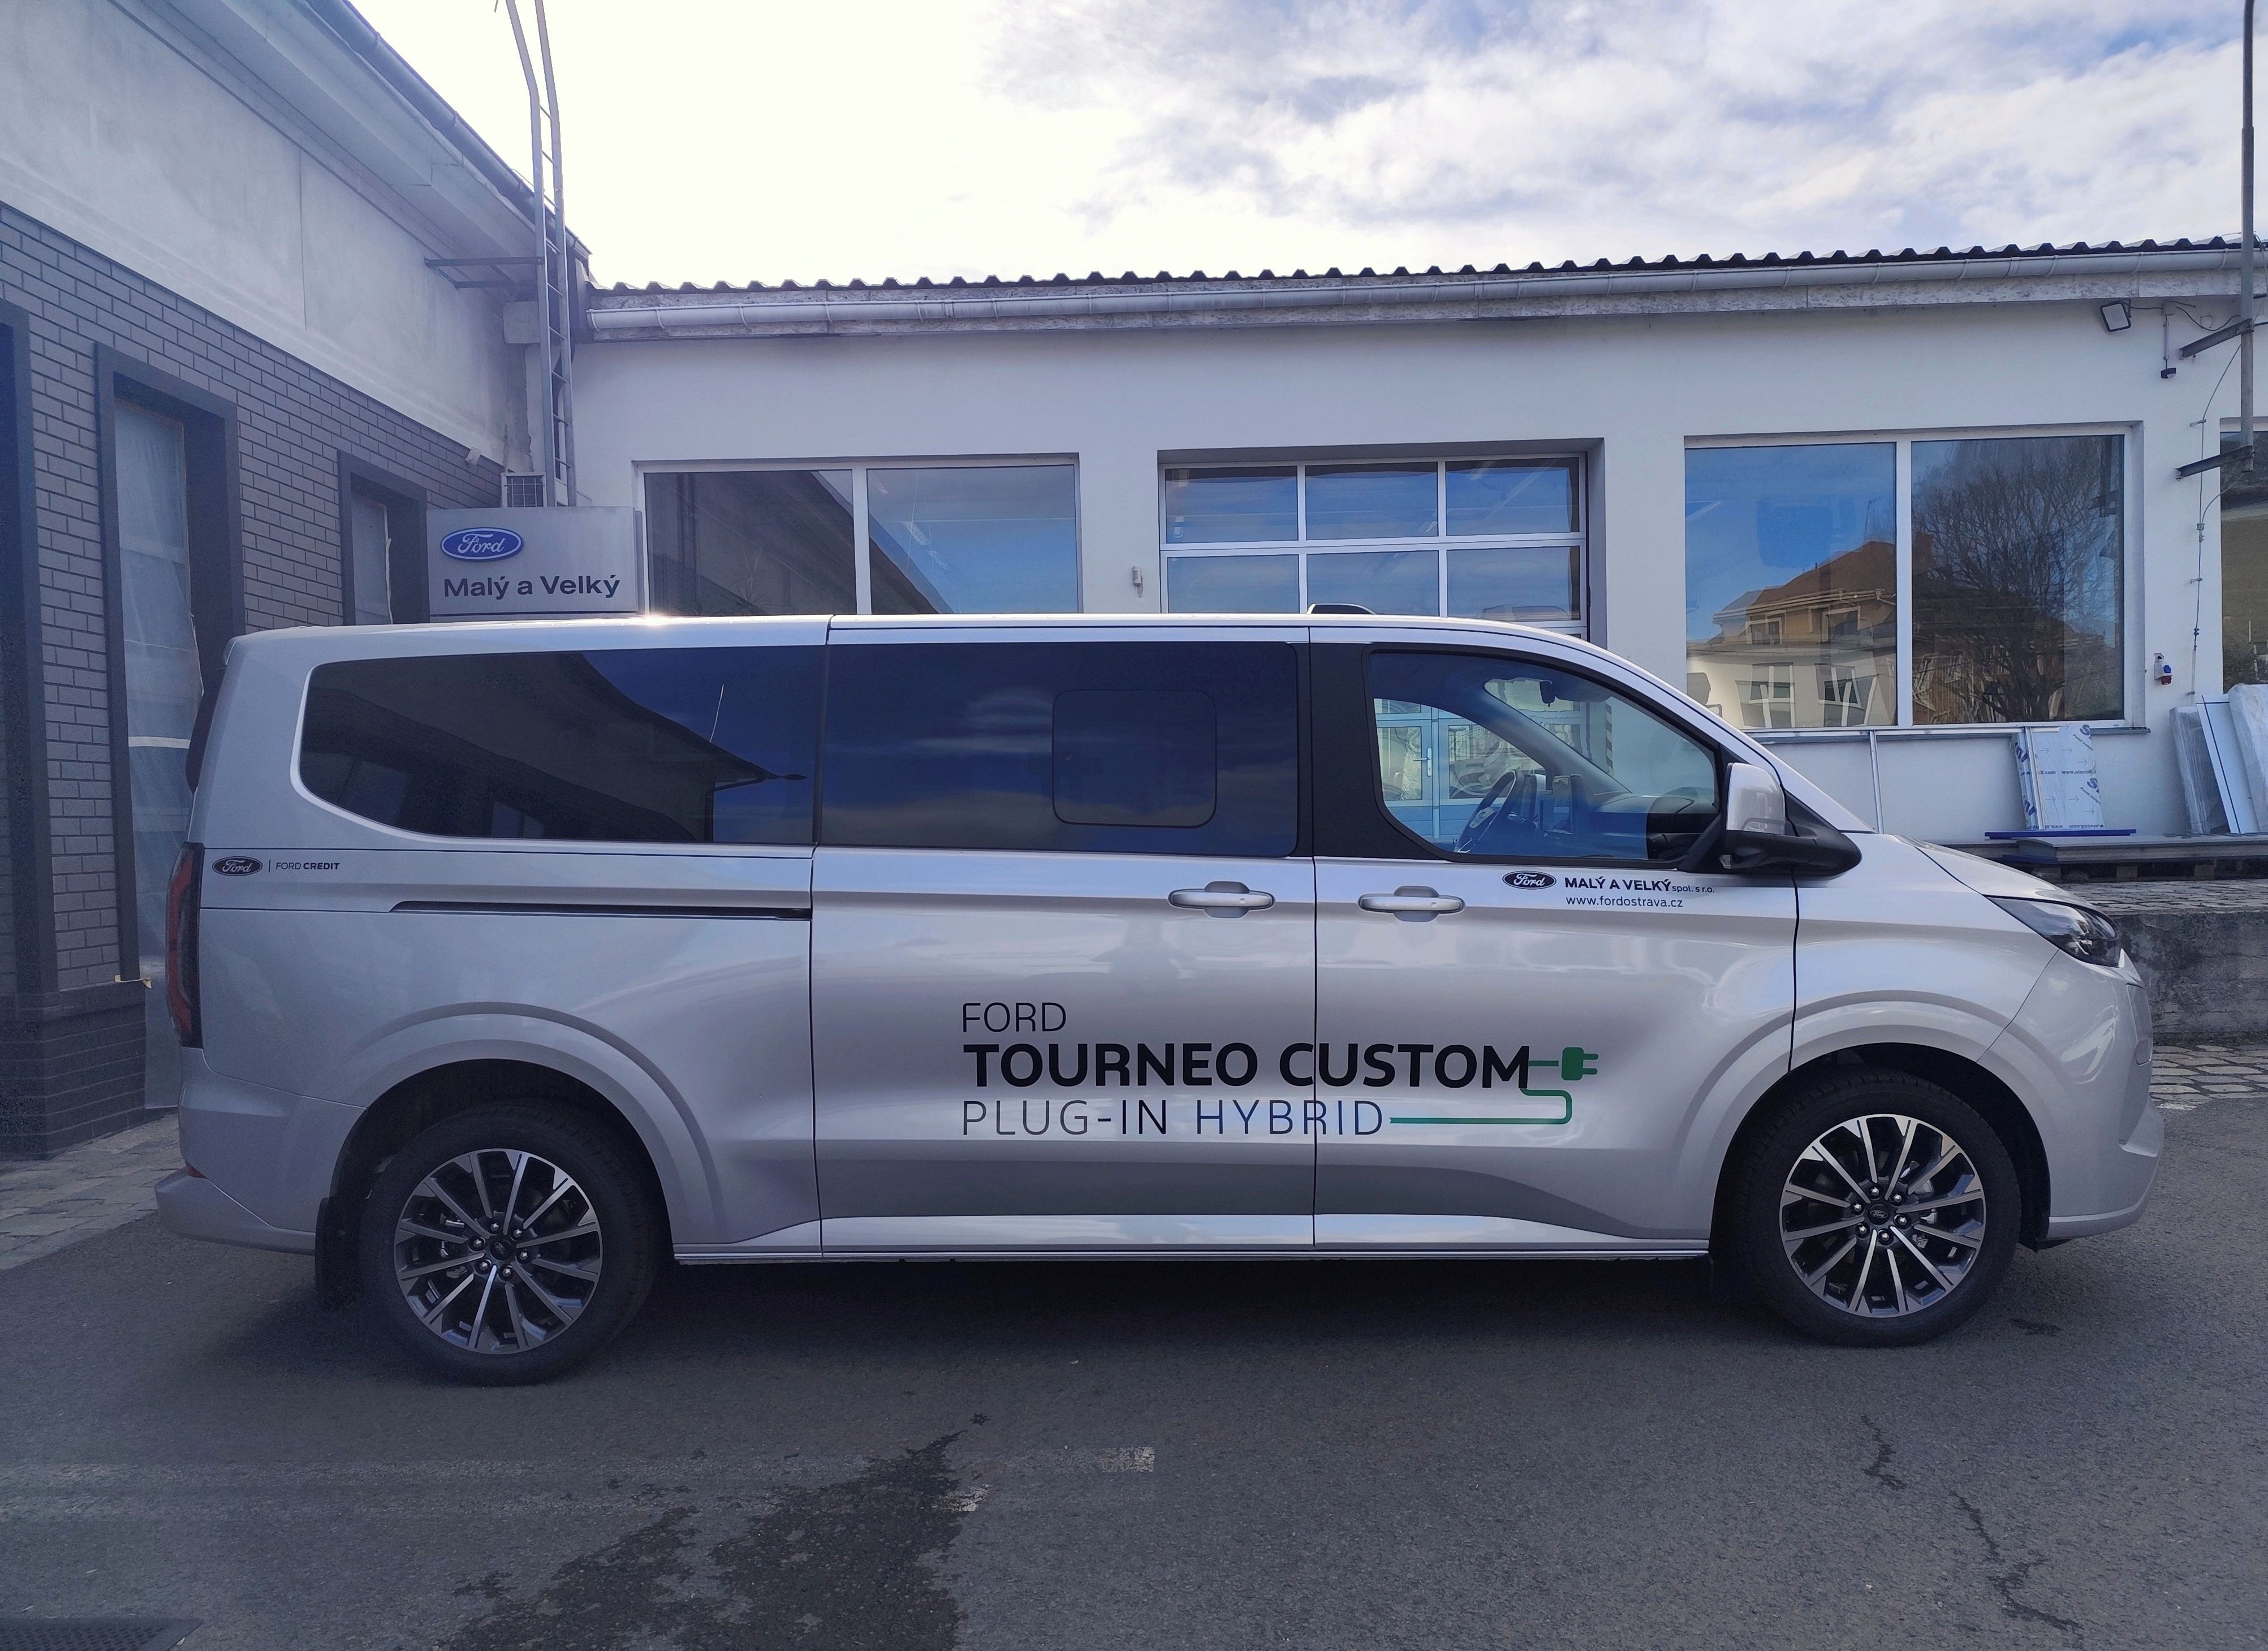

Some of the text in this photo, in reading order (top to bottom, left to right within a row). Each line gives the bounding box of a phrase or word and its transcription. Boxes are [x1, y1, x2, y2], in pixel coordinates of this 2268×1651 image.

[457, 533, 506, 554] Ford
[444, 574, 620, 600] Malý a Velký
[222, 859, 253, 873] Ford
[1513, 873, 1546, 887] Ford
[1564, 876, 1606, 890] MALÝ
[1609, 880, 1620, 890] A
[1622, 878, 1672, 892] VELKÝ
[1672, 885, 1694, 893] spol.
[1566, 895, 1683, 908] www.fordostrava.cz
[963, 1002, 1066, 1032] FORD
[963, 1042, 1529, 1089] TOURNEO CUSTOM
[963, 1100, 1383, 1136] PLUG-IN HYBRID
